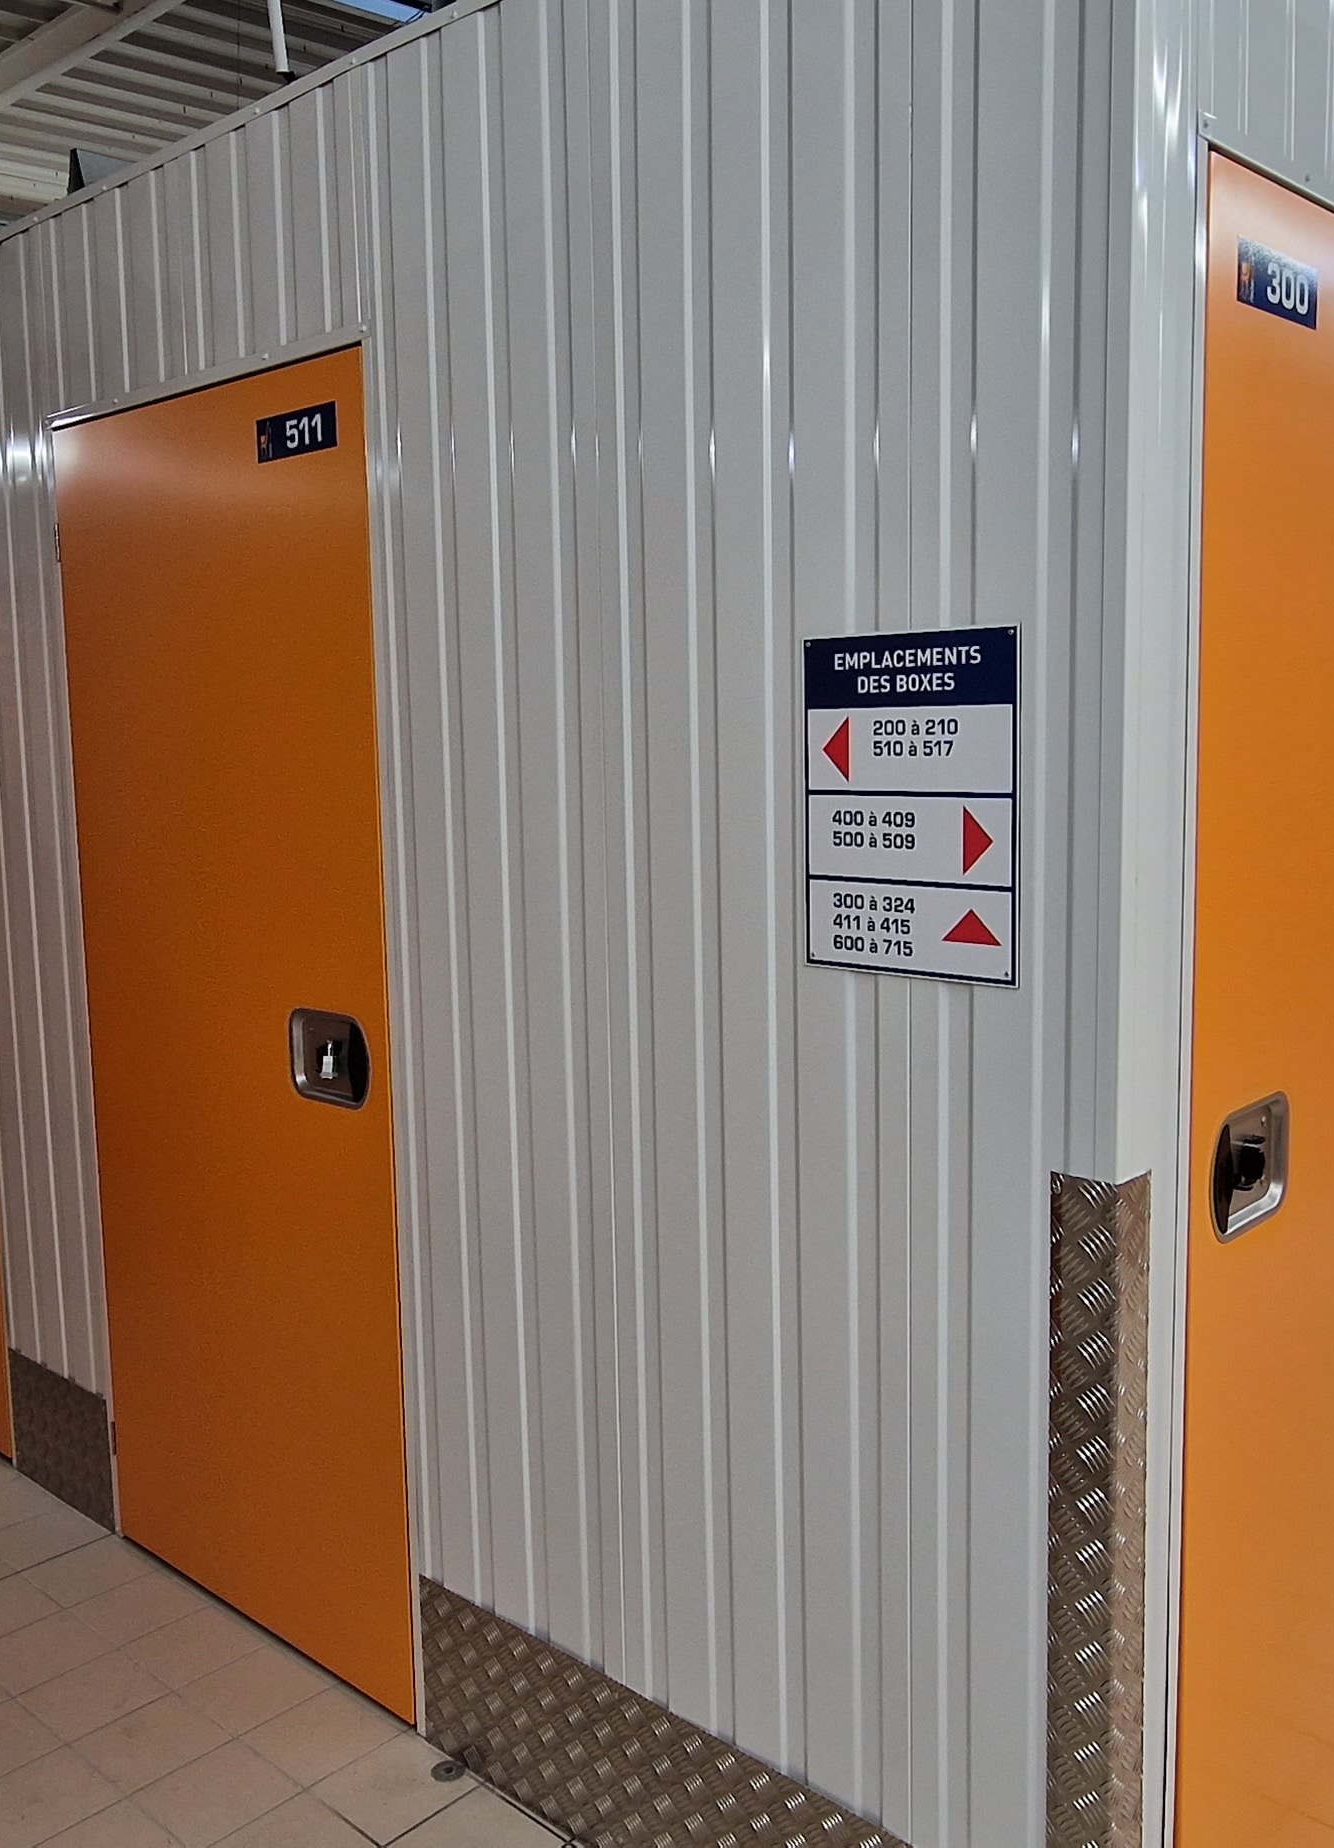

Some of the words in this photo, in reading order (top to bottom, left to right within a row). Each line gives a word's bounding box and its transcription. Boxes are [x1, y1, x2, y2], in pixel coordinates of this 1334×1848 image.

[1266, 261, 1309, 316] 300
[285, 412, 323, 449] 511
[834, 645, 982, 671] EMPLACEMENTS
[857, 675, 891, 694] DES
[896, 672, 956, 693] BOXES
[873, 719, 906, 736] 200
[911, 720, 920, 736] à
[925, 718, 959, 736] 210
[873, 740, 904, 757] 510
[908, 741, 918, 757] à
[923, 740, 954, 757] 517
[832, 810, 864, 827] 400
[868, 811, 877, 827] à
[881, 811, 916, 828] 409
[832, 831, 864, 848] 500
[868, 833, 877, 849] à
[882, 833, 916, 850] 509
[833, 892, 865, 910] 300
[869, 895, 878, 911] à
[882, 896, 916, 914] 324
[833, 914, 861, 931] 411
[867, 917, 876, 932] à
[880, 917, 911, 935] 415
[833, 935, 865, 953] 600
[869, 937, 878, 954] à
[882, 939, 914, 957] 715
